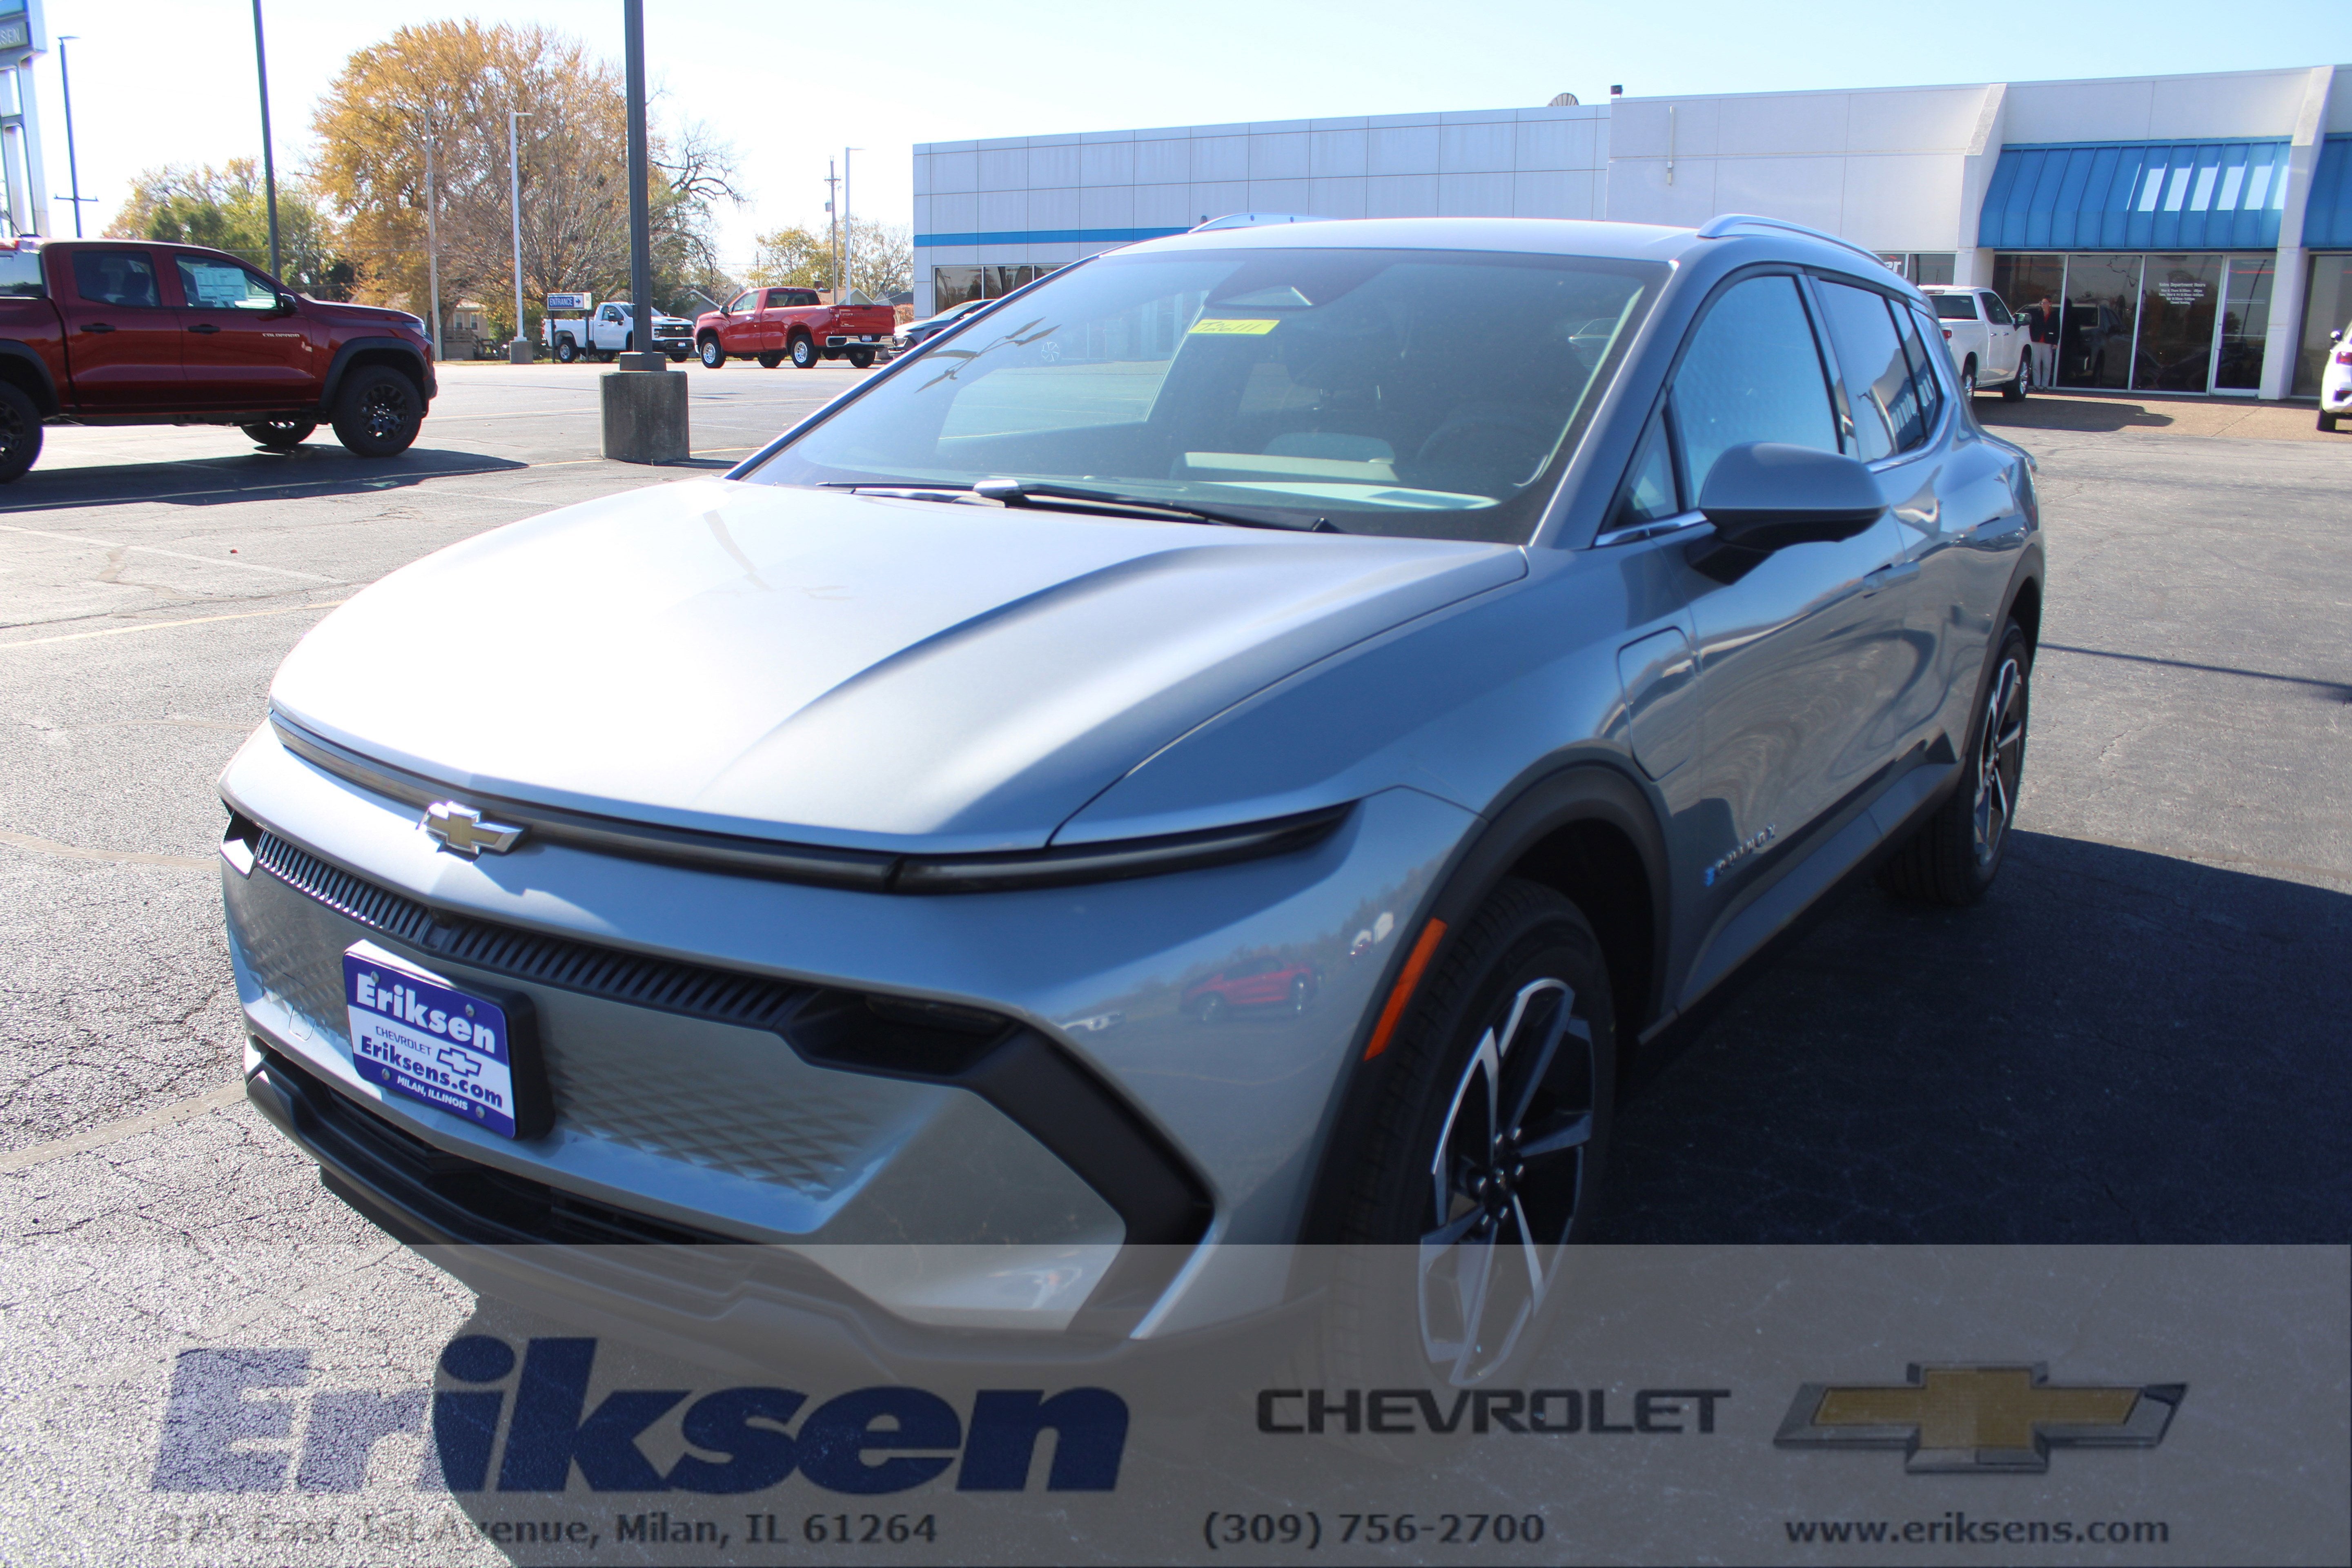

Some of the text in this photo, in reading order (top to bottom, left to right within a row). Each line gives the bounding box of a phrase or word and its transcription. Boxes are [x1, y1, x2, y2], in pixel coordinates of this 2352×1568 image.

[550, 298, 573, 306] ENTRANCE
[356, 973, 496, 1054] Eriksen
[375, 1025, 432, 1056] CHEVROLET
[361, 1035, 503, 1109] Eriksens.com
[397, 1075, 468, 1111] MILAN, ILLINOIS
